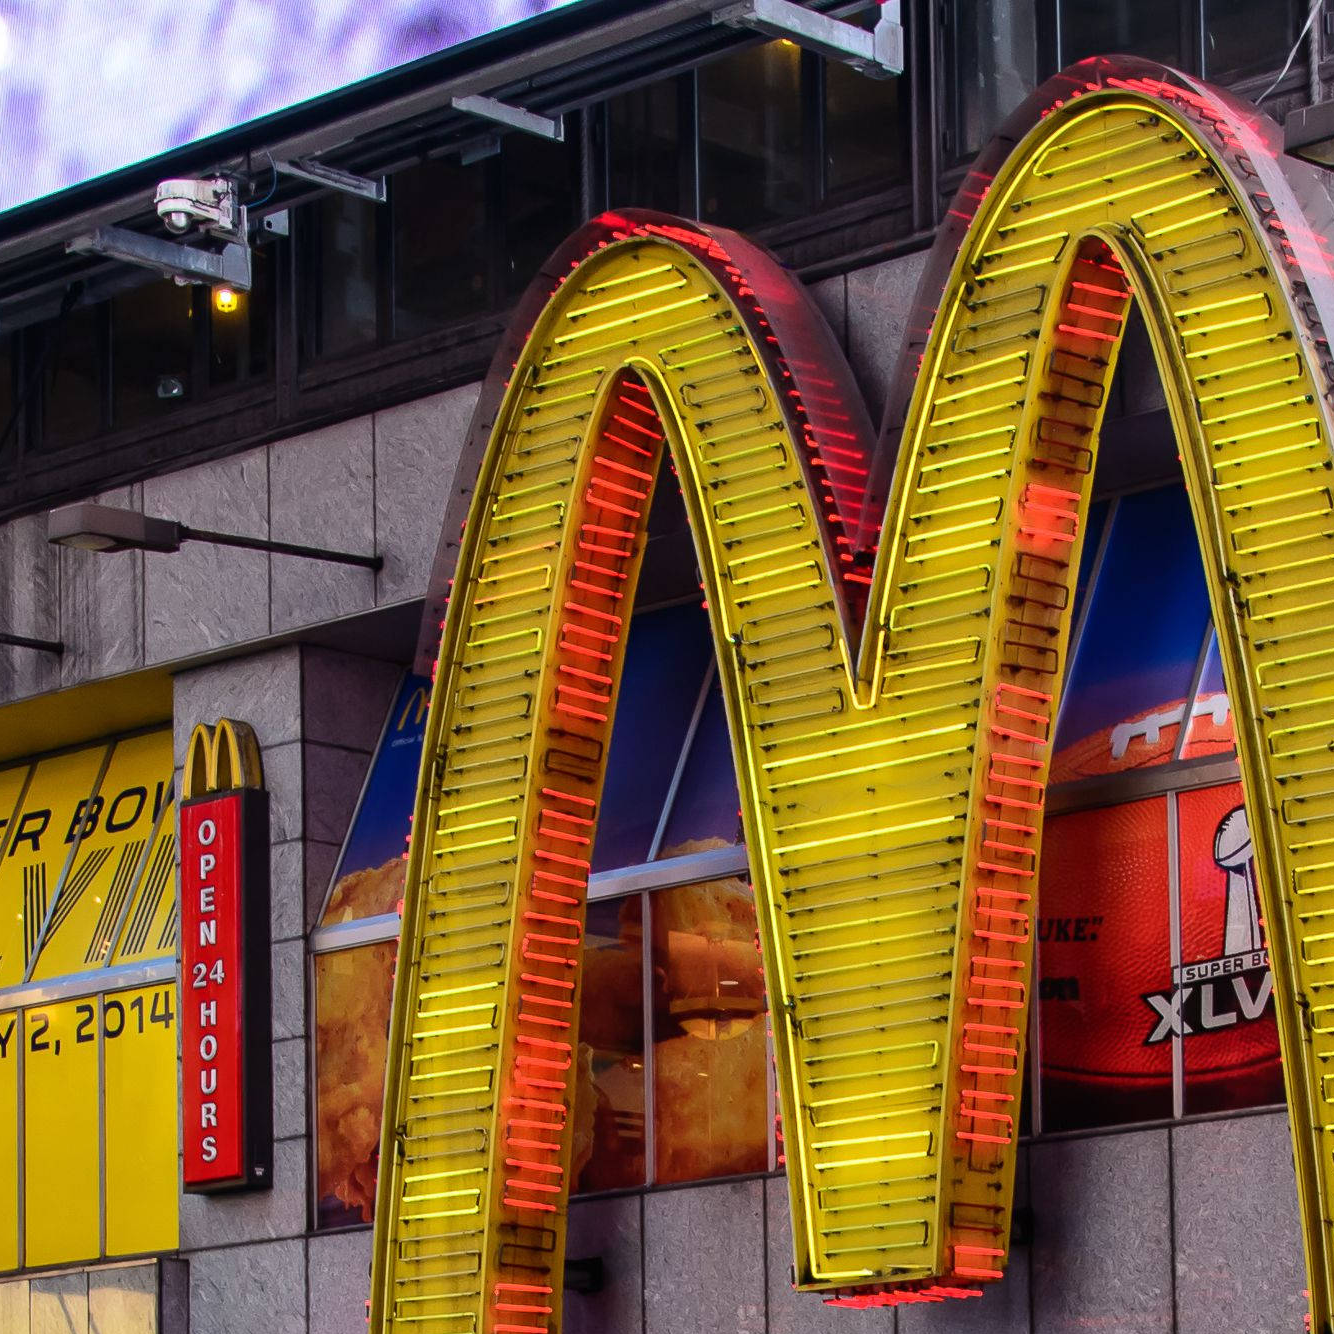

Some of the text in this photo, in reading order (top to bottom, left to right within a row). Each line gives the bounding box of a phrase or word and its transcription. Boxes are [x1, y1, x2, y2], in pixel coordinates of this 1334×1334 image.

[197, 818, 218, 947] OPEN
[192, 958, 225, 990] 24
[1186, 957, 1244, 981] SUPER
[31, 1012, 61, 1057] 2,
[75, 990, 175, 1044] 2014
[200, 1001, 219, 1163] HOURS
